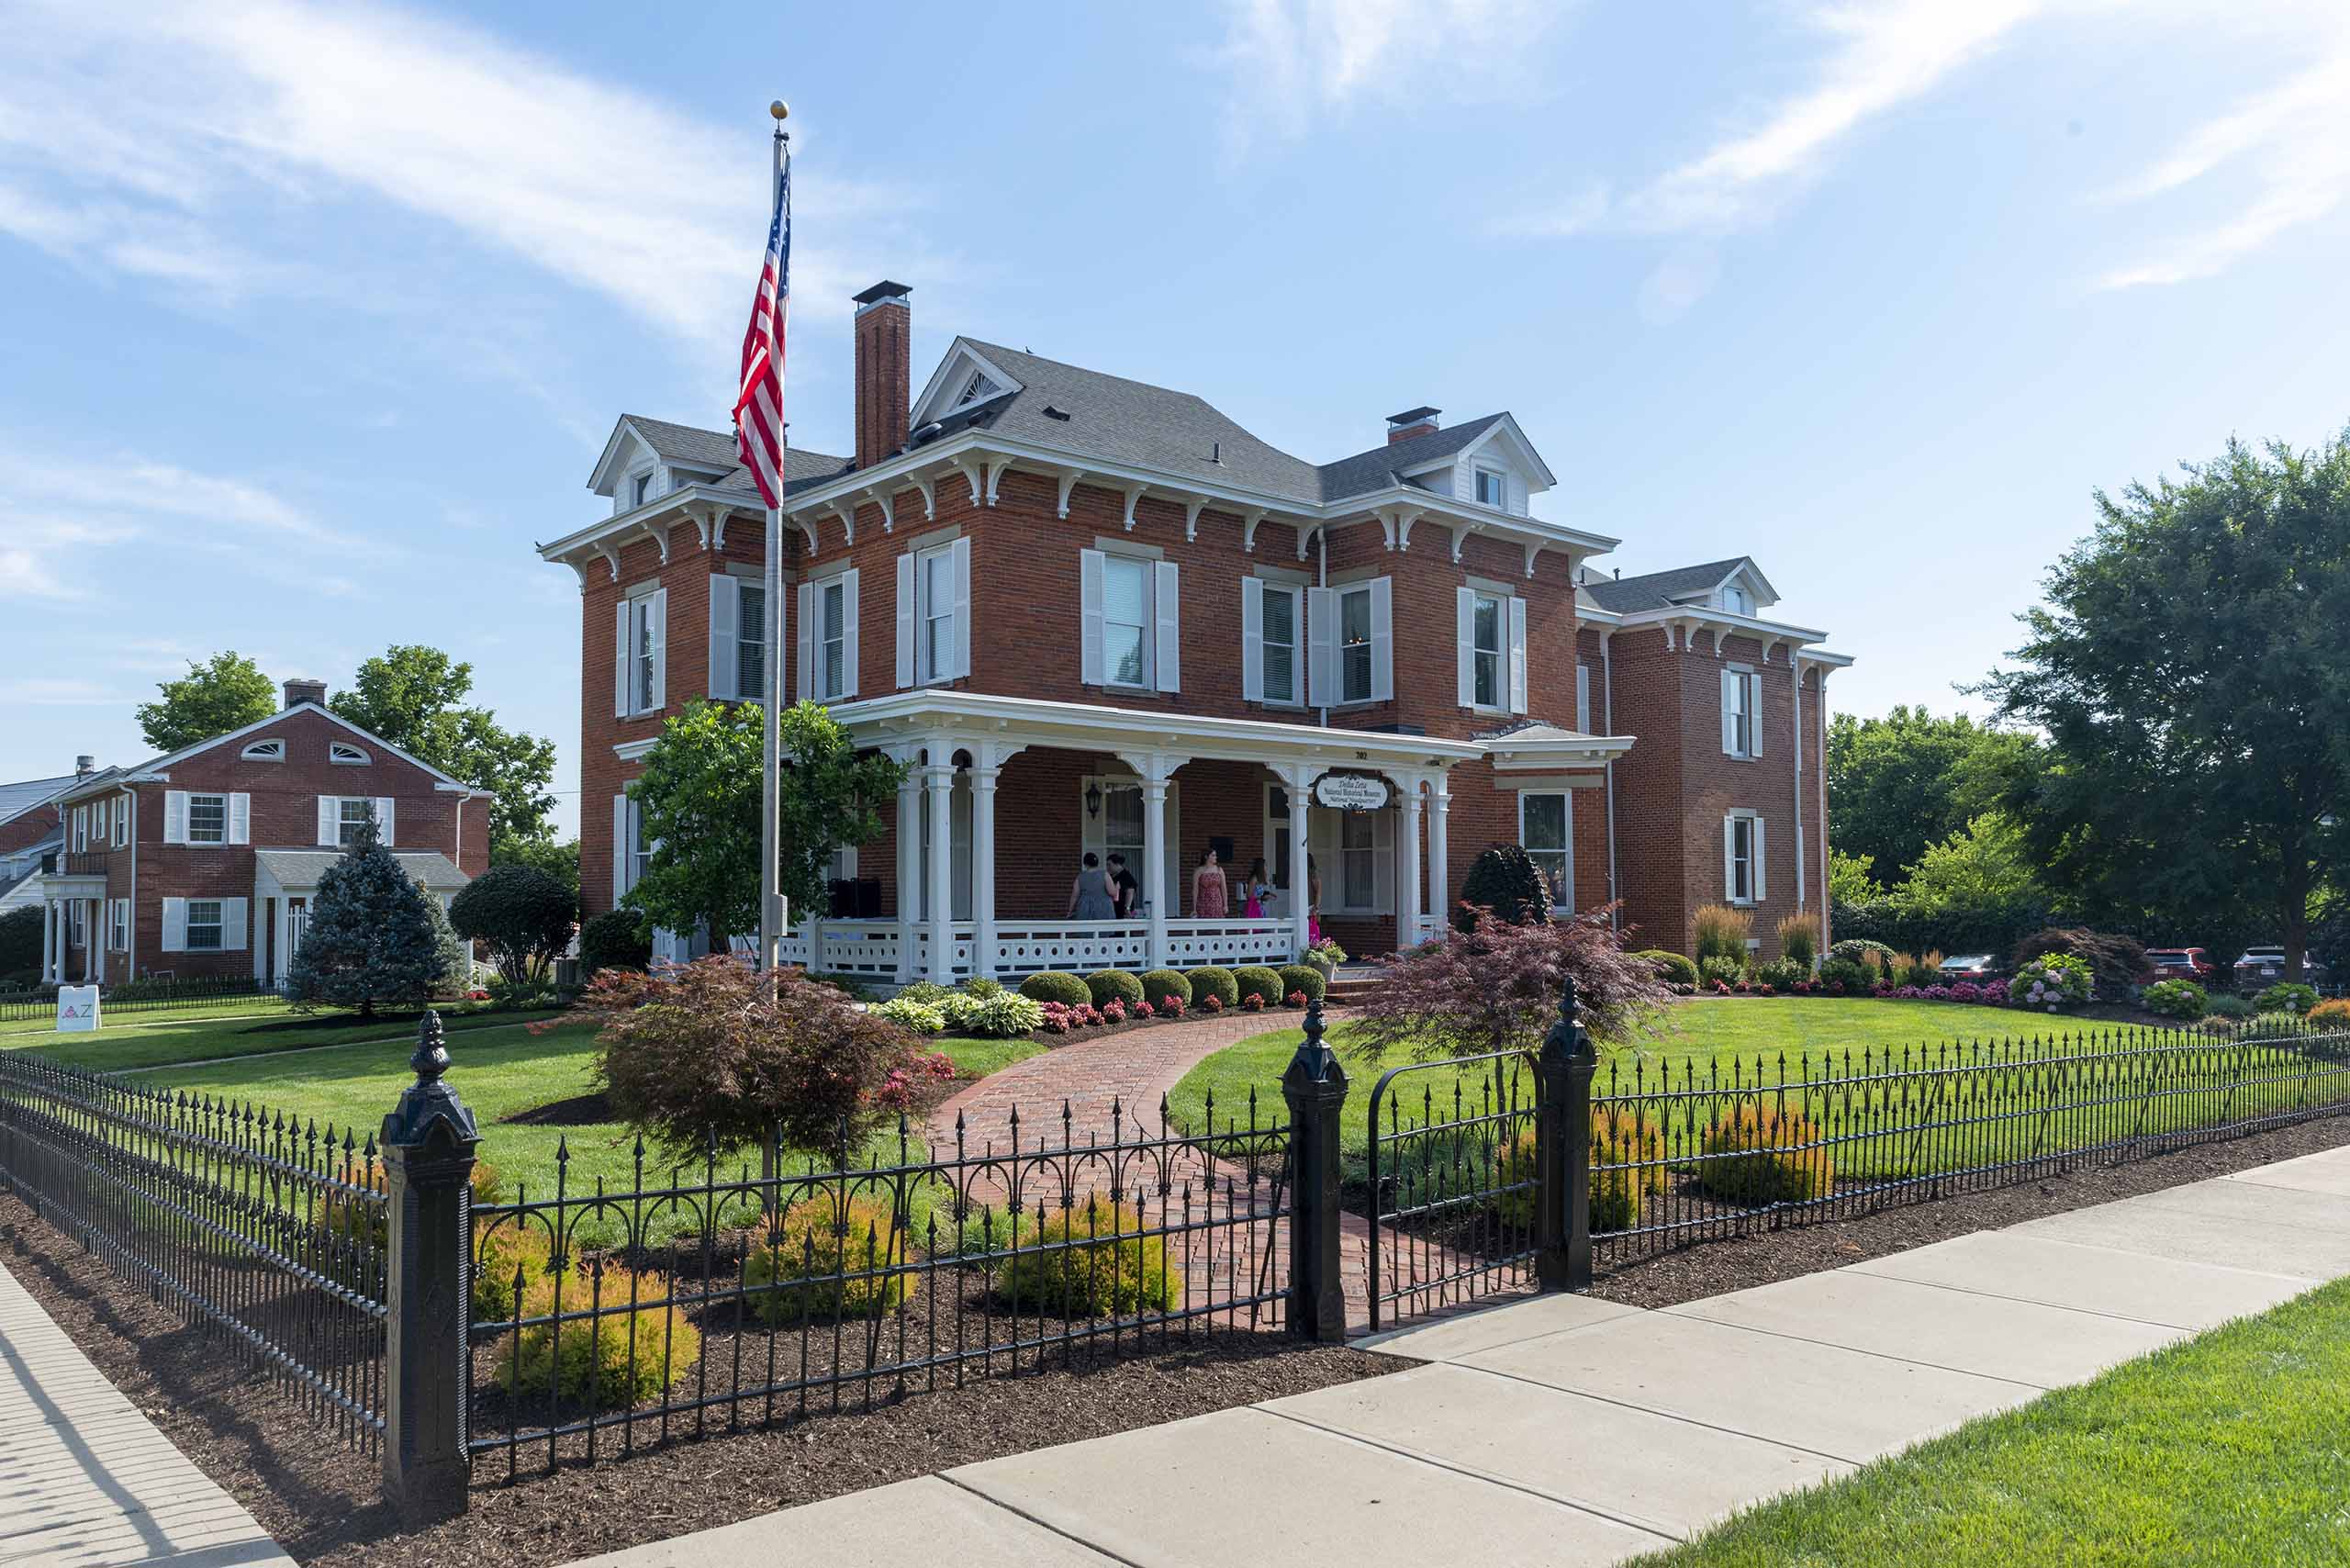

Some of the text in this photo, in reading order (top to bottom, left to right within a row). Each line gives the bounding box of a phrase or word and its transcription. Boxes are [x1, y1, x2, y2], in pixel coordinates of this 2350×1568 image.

[1337, 780, 1367, 789] Delta Zeta
[1324, 787, 1342, 796] National
